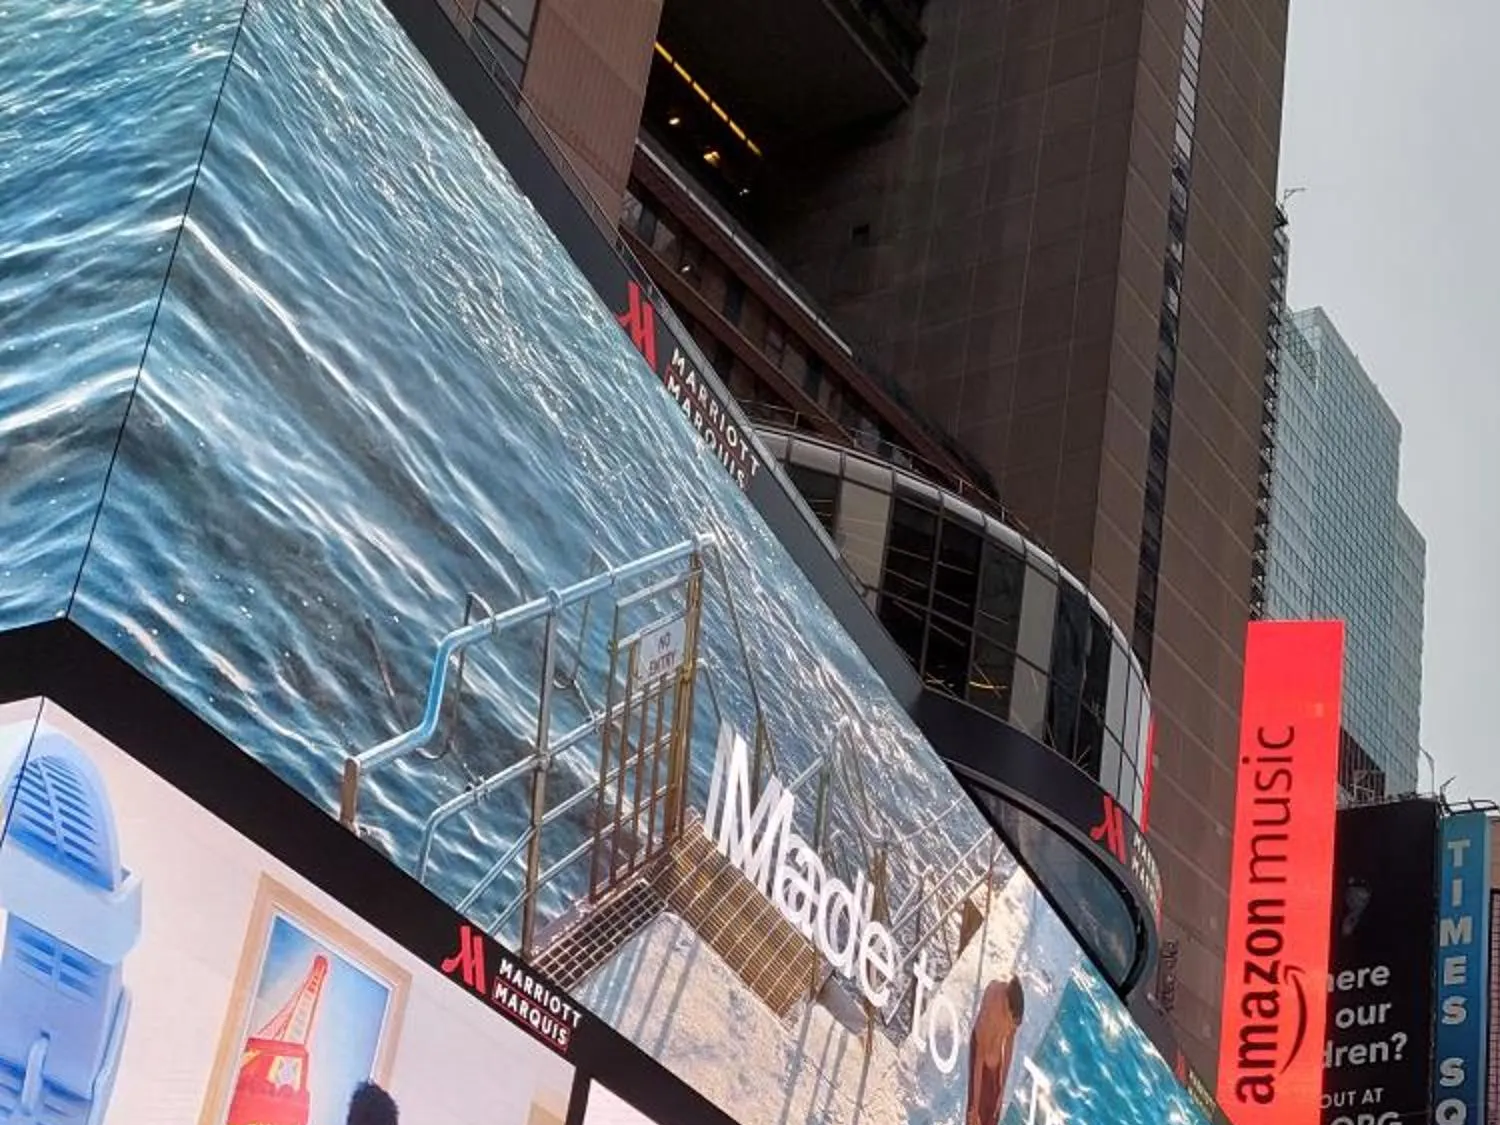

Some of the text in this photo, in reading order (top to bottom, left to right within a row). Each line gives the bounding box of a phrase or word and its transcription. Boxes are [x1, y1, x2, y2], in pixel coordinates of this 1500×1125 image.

[672, 347, 760, 477] MARRIOTT
[705, 720, 895, 1007] Made
[910, 948, 960, 1074] to
[1235, 724, 1296, 1106] amazon music
[1438, 836, 1473, 1027] TIMES
[495, 982, 569, 1046] MARQUIS
[499, 956, 583, 1029] MARRIOTT
[1335, 1001, 1392, 1030] our
[1361, 1087, 1385, 1105] AT
